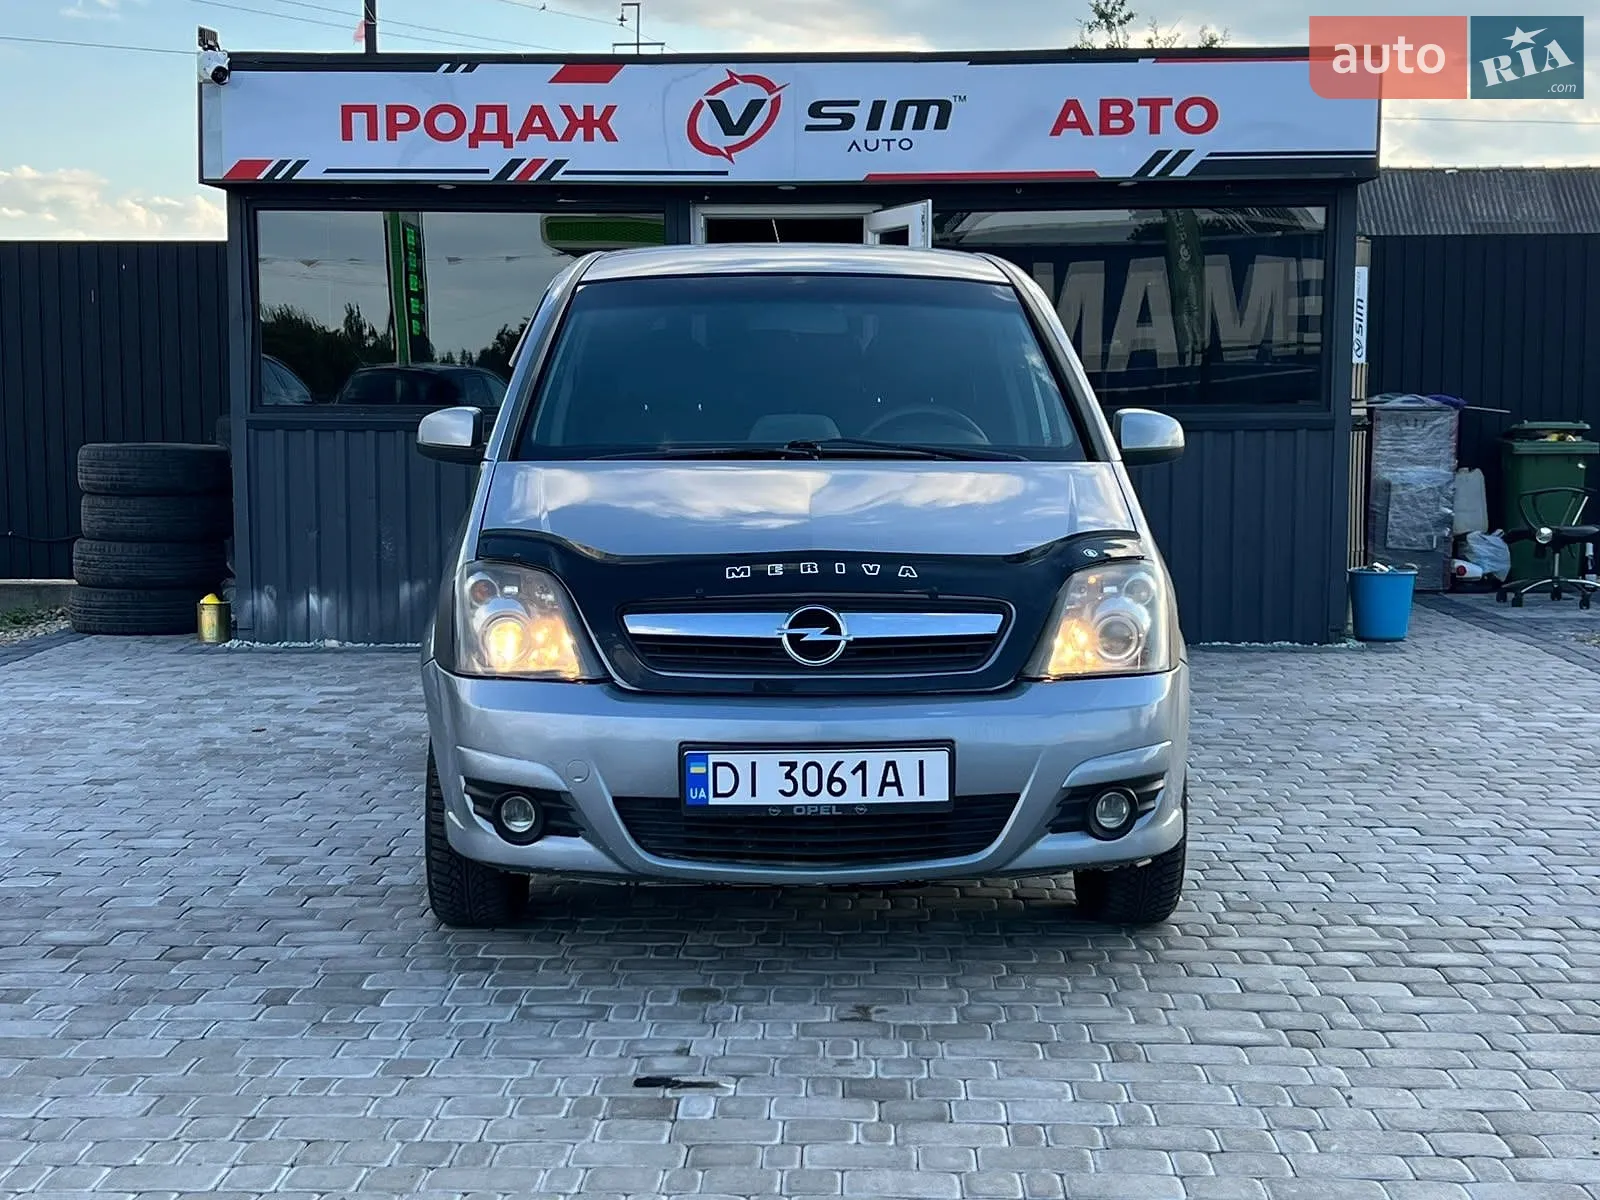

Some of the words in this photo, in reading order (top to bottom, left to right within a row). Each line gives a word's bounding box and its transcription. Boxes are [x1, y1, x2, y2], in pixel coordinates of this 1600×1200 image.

[340, 103, 619, 149] ПРОДАЖ
[706, 99, 768, 136] V
[804, 99, 953, 131] SIM
[1049, 96, 1219, 136] АВТО
[847, 138, 914, 152] AUTO
[725, 562, 918, 579] MERIVA
[690, 787, 708, 800] UA
[712, 761, 757, 798] DI
[793, 805, 842, 816] OPEL
